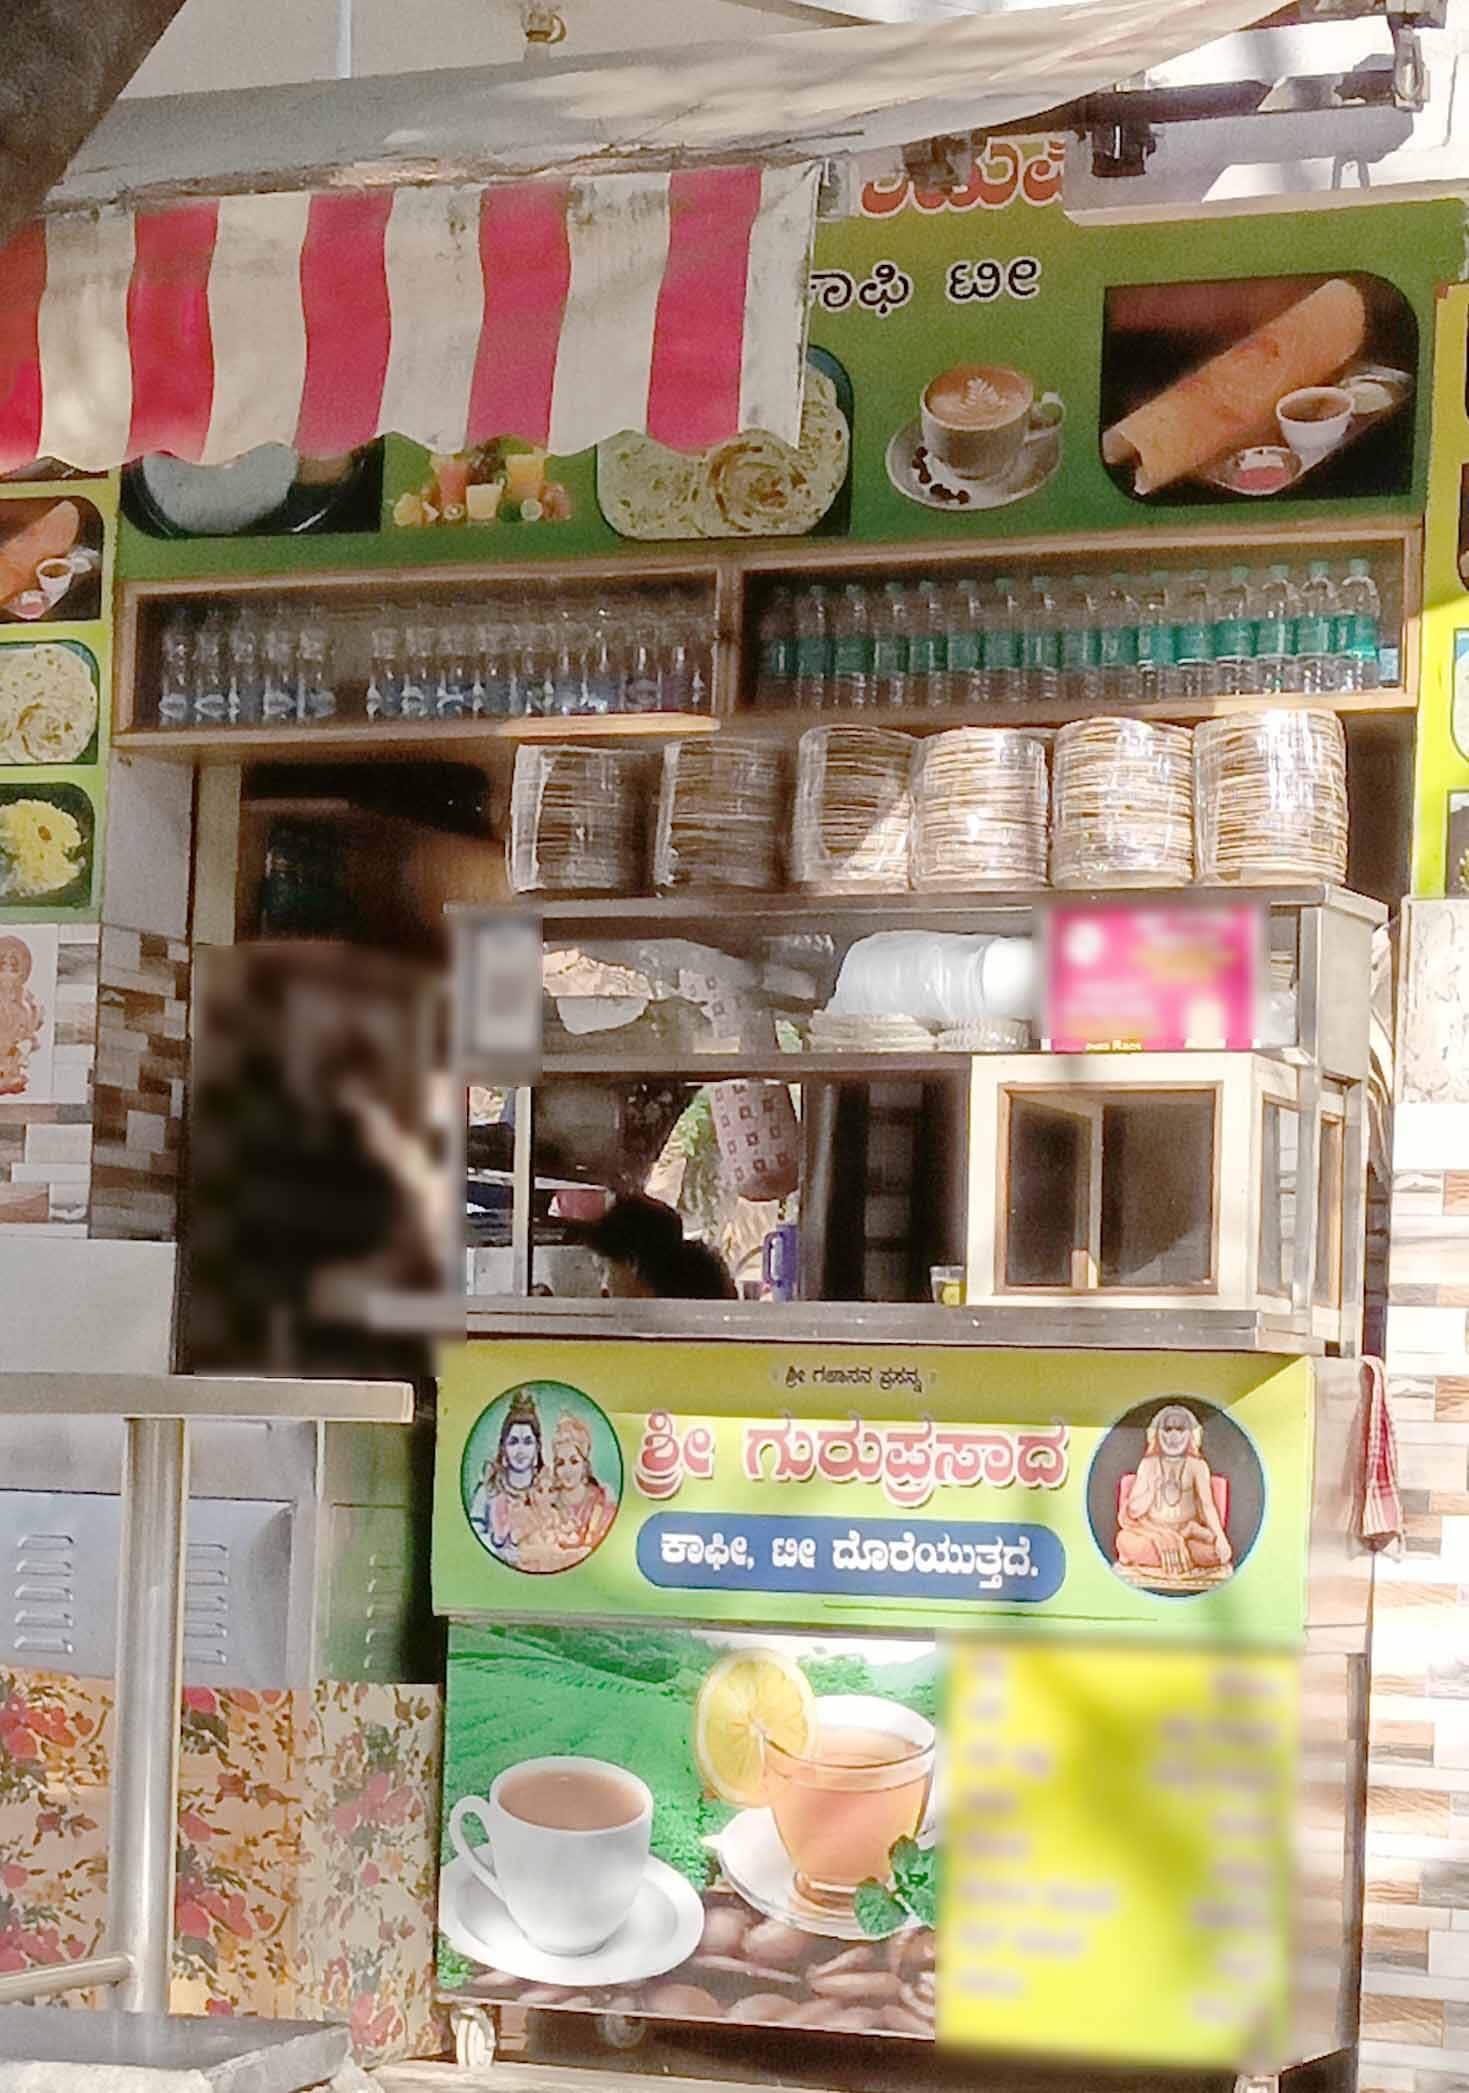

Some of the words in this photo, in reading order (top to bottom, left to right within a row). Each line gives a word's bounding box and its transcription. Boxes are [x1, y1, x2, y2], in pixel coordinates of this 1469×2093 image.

[948, 258, 1040, 303] ಟೀ
[634, 1410, 716, 1500] ಶ್ರೀ
[742, 1411, 1070, 1508] ಗುರುಪ್ರಸಾದ
